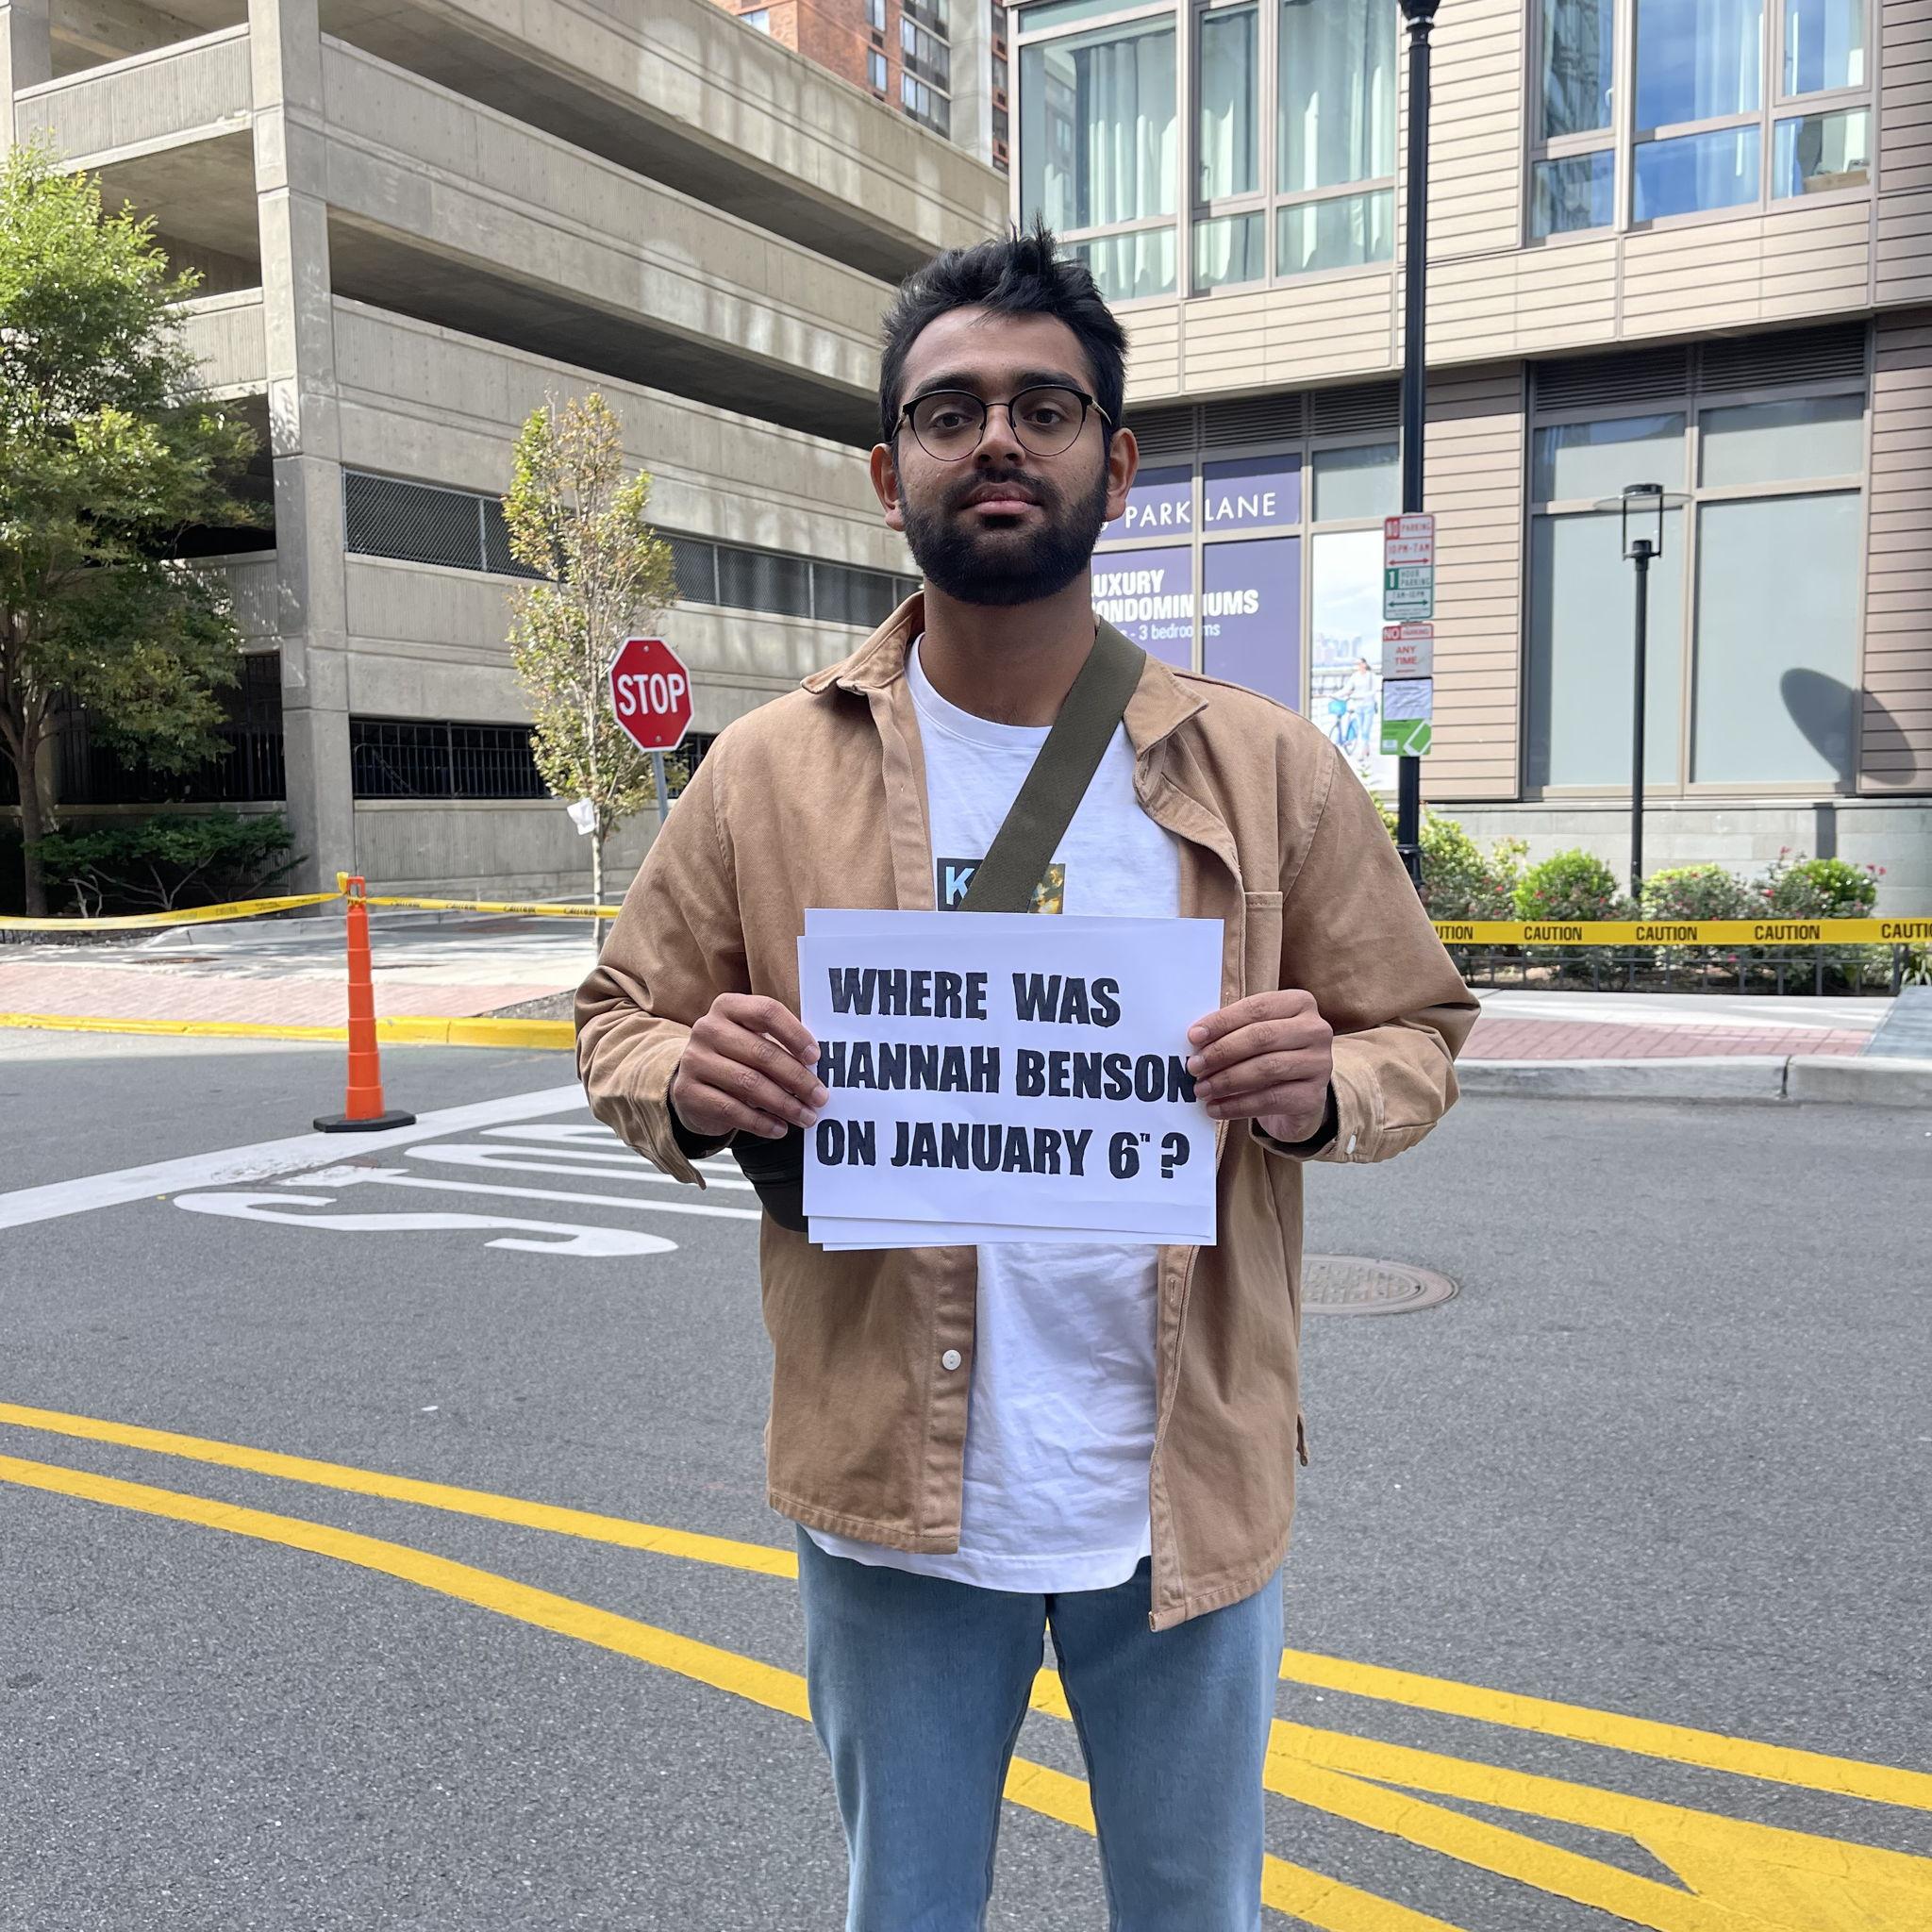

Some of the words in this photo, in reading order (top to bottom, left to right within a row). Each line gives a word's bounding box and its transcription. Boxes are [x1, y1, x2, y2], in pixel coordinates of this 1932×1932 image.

[1124, 500, 1191, 528] PARK
[1205, 491, 1276, 522] LANE
[1402, 522, 1431, 533] PARKING
[1389, 570, 1395, 589] 1
[1401, 576, 1431, 587] PARKING
[1138, 625, 1148, 641] 3
[1383, 627, 1399, 641] NO
[1396, 645, 1417, 654] ANY
[1395, 656, 1418, 665] TIME
[617, 673, 686, 716] STOP
[1435, 925, 1474, 940] UTION
[1524, 925, 1583, 941] CAUTION
[1636, 925, 1698, 941] CAUTION
[1754, 924, 1821, 941] CAUTION
[1881, 923, 1932, 939] CAUTI
[828, 967, 989, 1020] WHERE
[1012, 973, 1121, 1028] WAS
[816, 1041, 1000, 1093] HANNAH
[1015, 1049, 1197, 1104] BENSON
[815, 1118, 876, 1167] ON
[890, 1120, 1094, 1176] JANUARY
